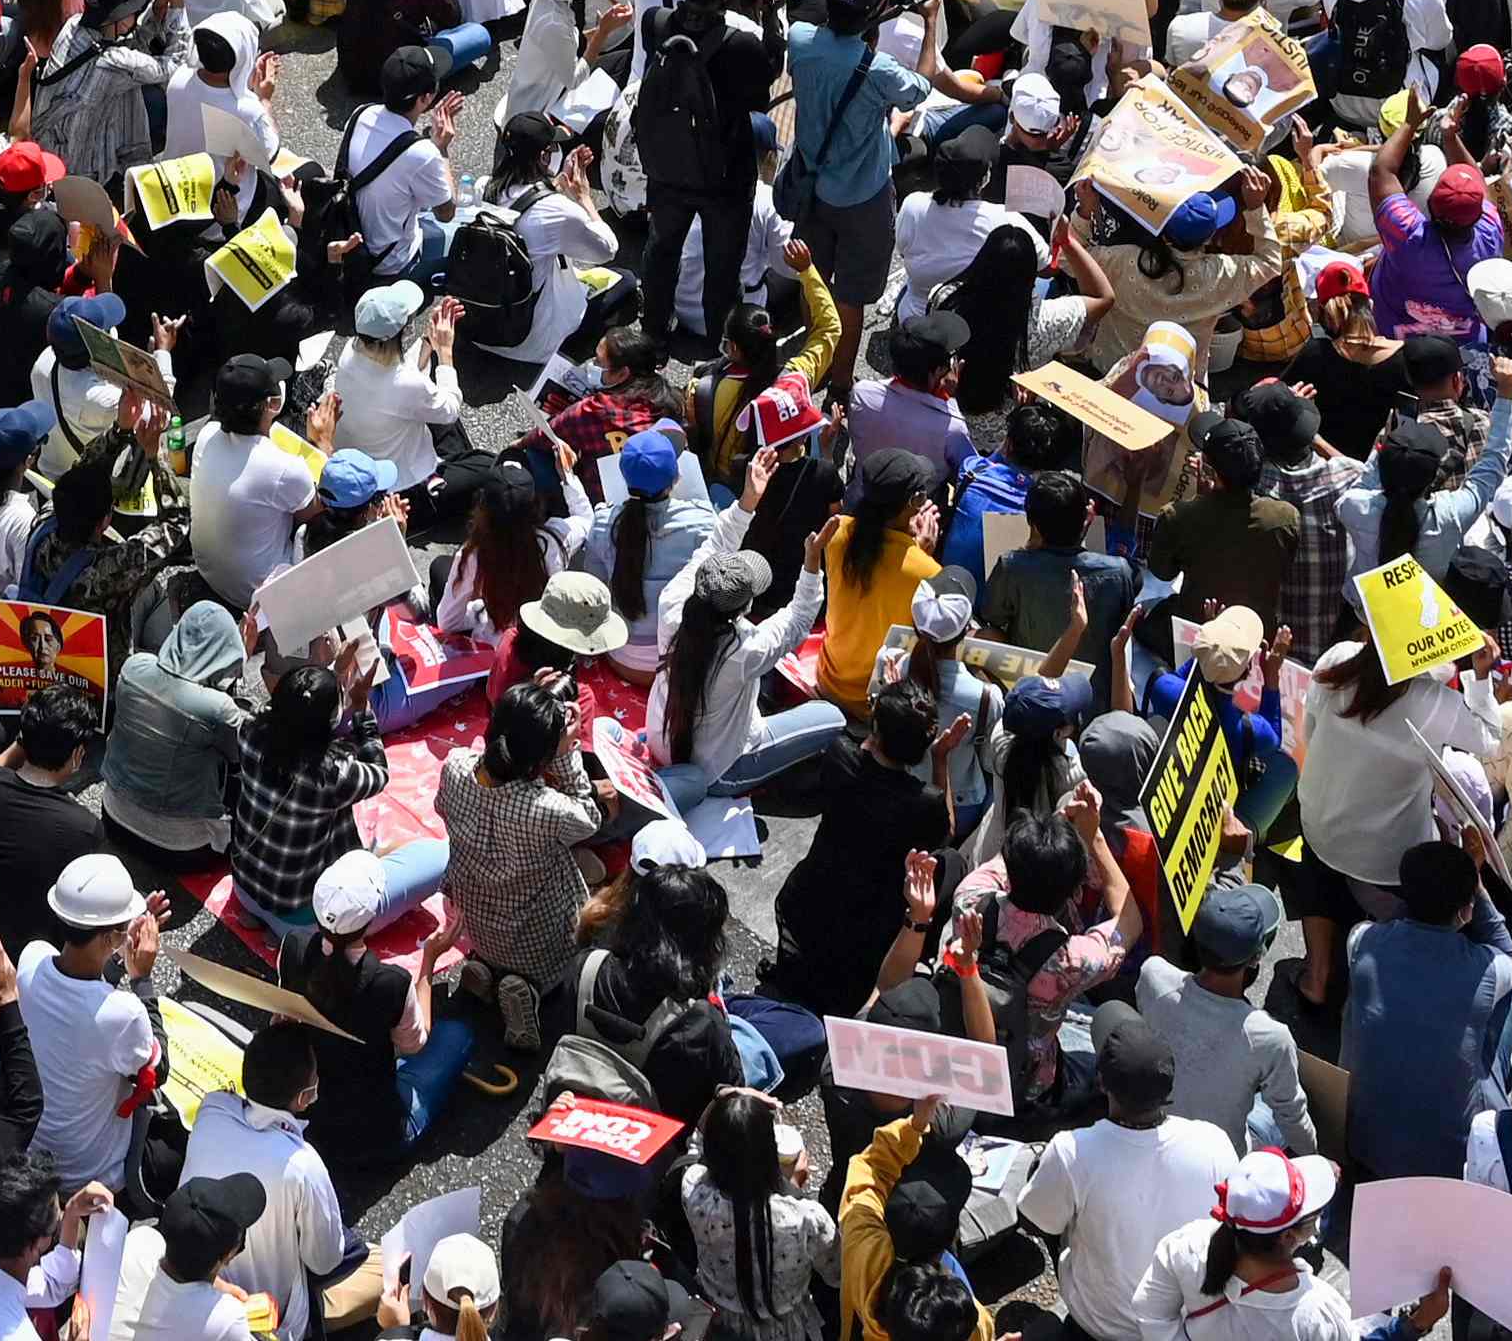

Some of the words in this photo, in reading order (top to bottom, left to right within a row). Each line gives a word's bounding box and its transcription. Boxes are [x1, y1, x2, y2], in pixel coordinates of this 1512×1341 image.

[38, 667, 67, 681] SAVE
[70, 672, 92, 687] OUR
[1403, 633, 1437, 656] OUR
[1435, 619, 1476, 642] VOTES
[1150, 755, 1182, 832] GIVE
[1173, 696, 1211, 760] BACK
[1171, 775, 1233, 909] DEMOCRACY
